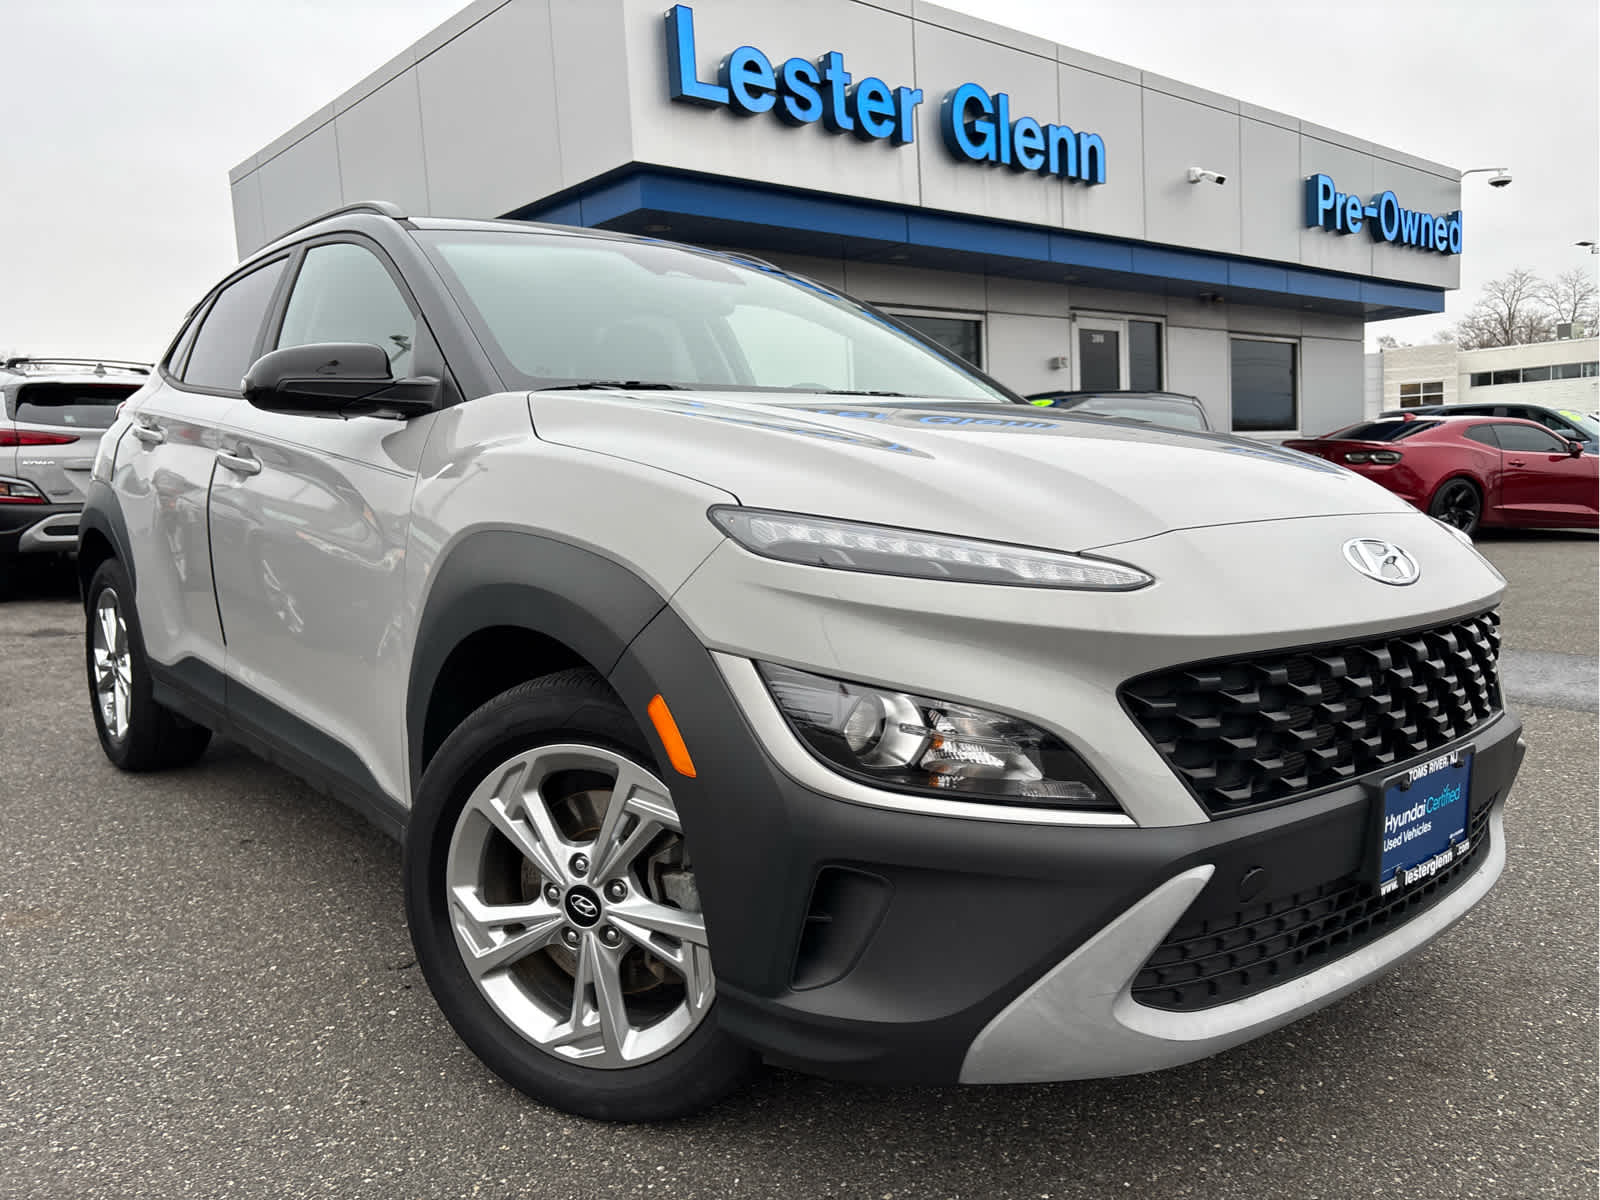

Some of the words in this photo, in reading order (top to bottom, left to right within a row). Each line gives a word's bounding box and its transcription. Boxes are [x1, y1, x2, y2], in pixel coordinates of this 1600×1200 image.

[665, 4, 923, 144] Lester
[942, 82, 1106, 185] Glenn
[1306, 174, 1462, 254] Pre-Owned
[1409, 765, 1428, 782] TOMS
[1450, 751, 1459, 765] NJ
[1383, 831, 1403, 853] Used
[1403, 821, 1432, 843] Vehicles
